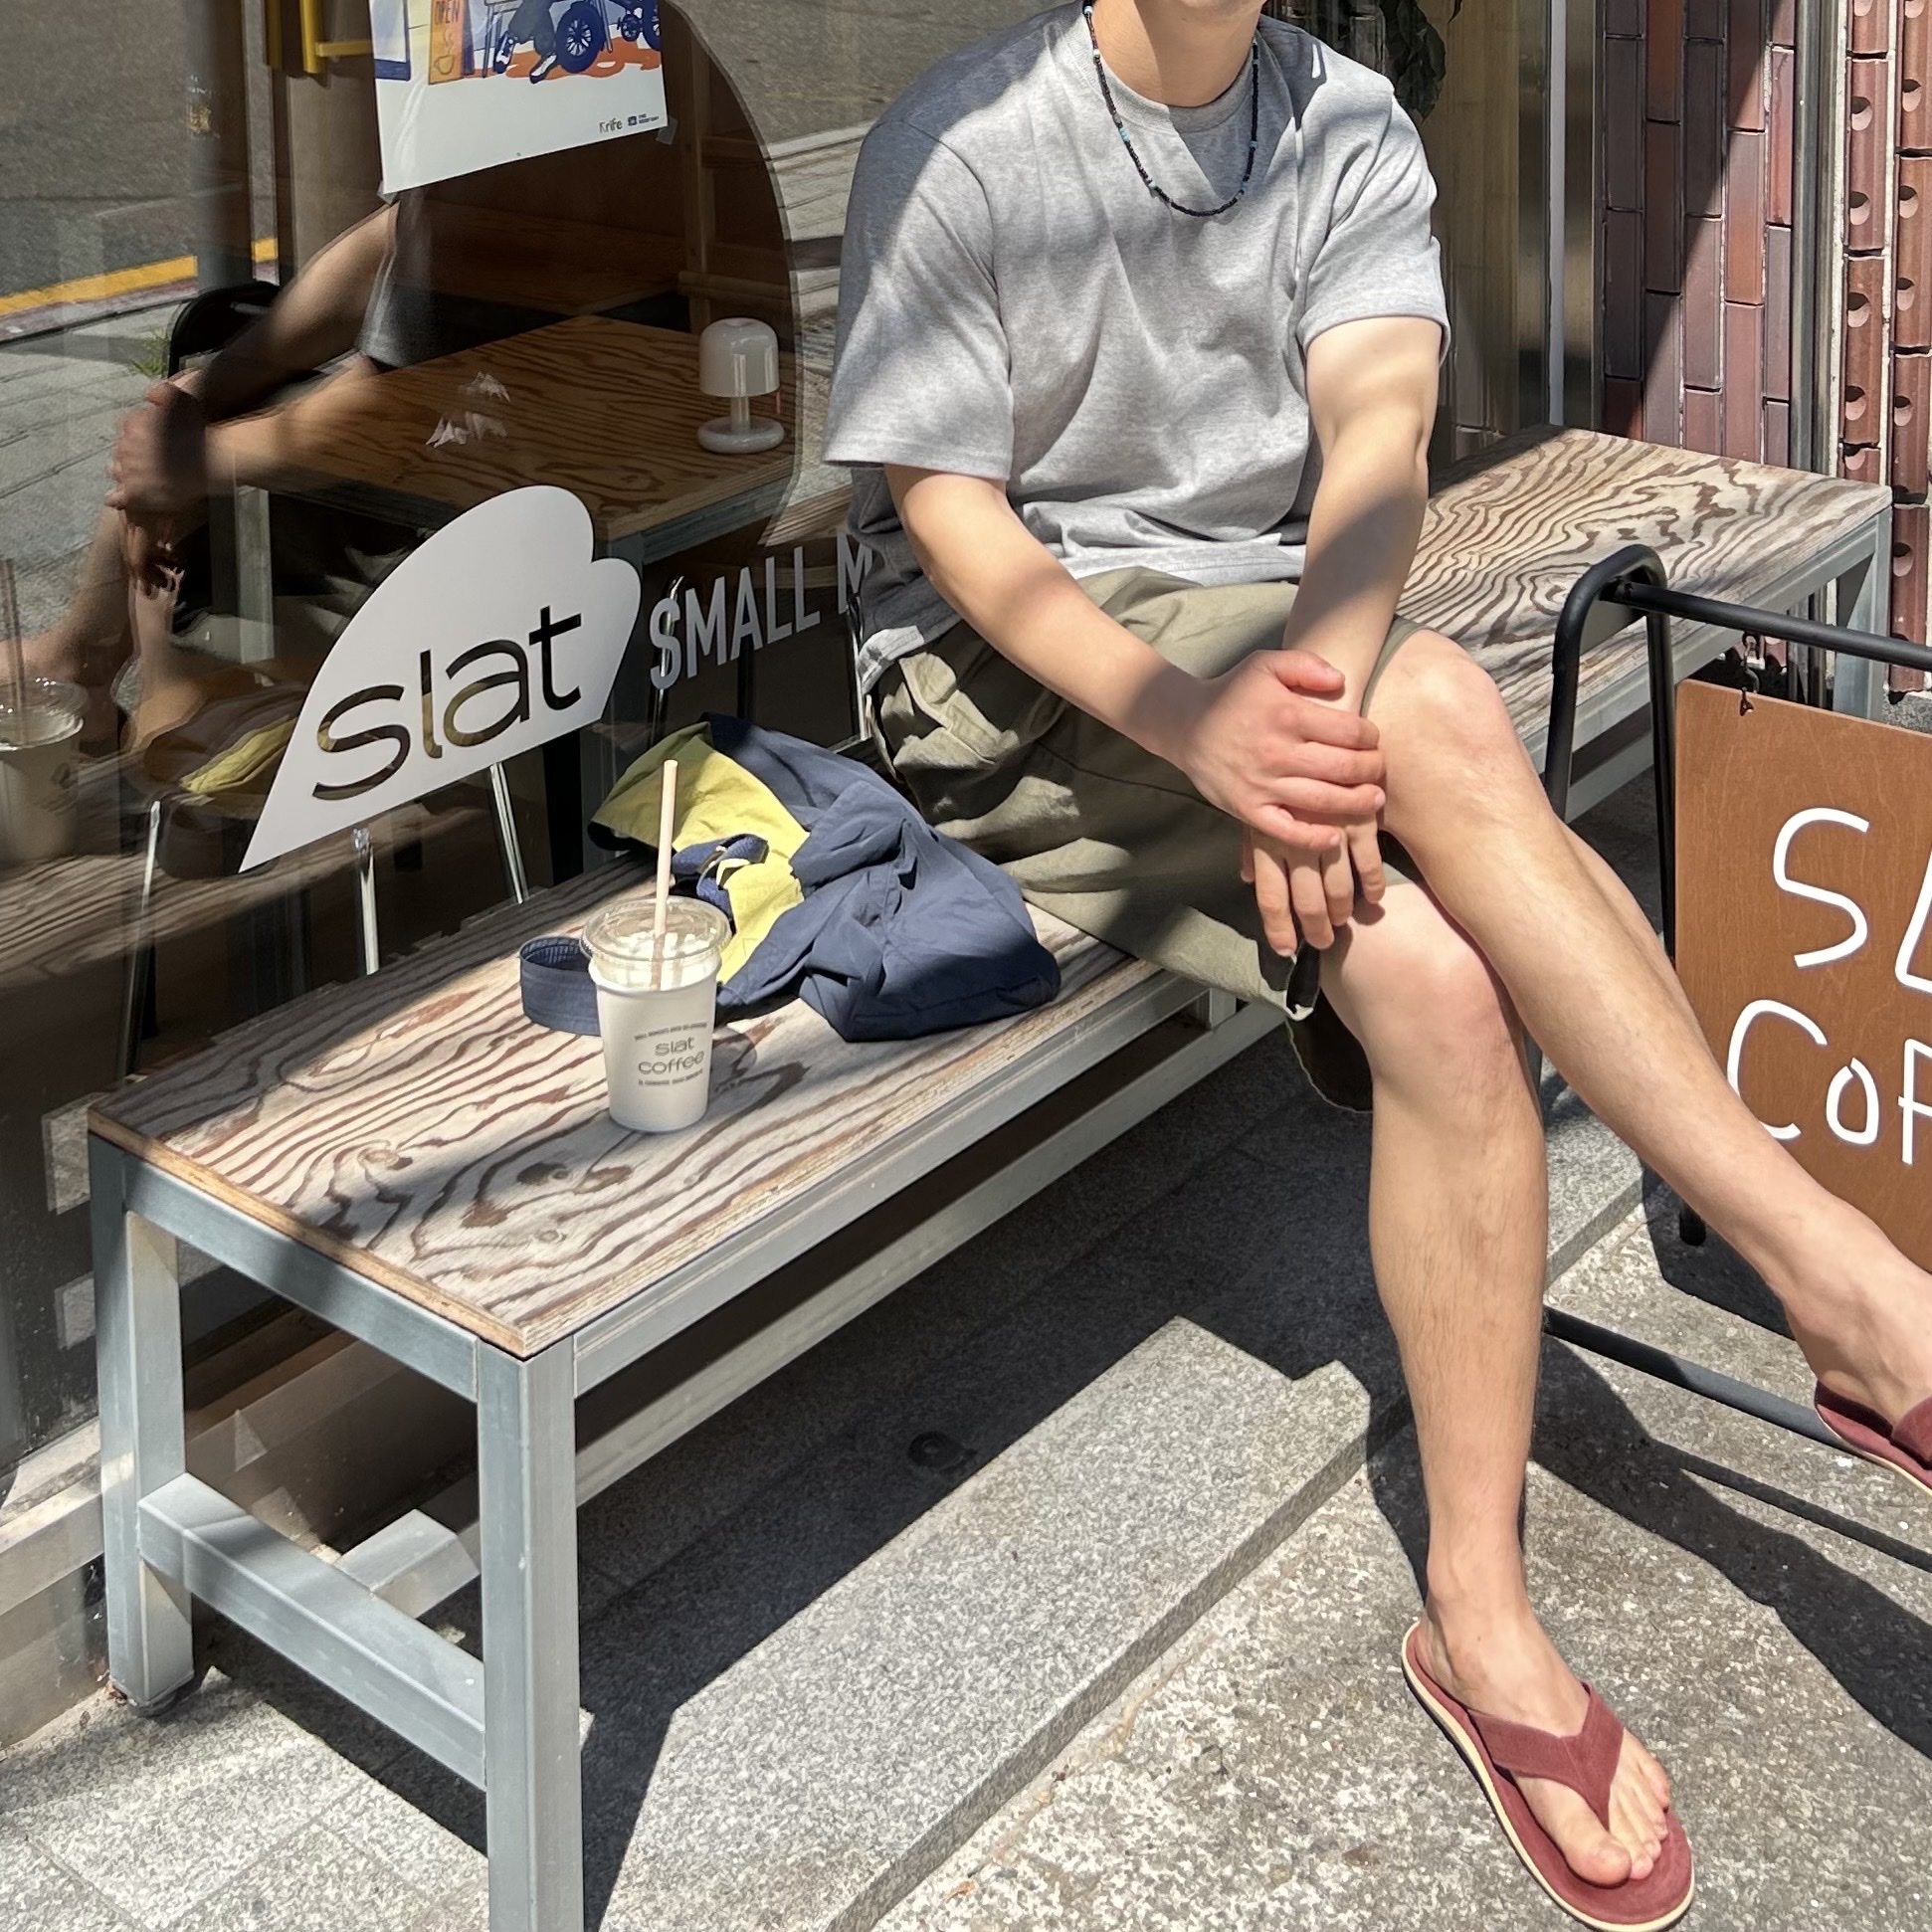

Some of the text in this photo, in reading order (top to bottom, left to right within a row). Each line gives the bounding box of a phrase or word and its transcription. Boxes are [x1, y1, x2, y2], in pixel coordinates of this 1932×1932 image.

[650, 545, 821, 689] SMALL
[312, 605, 582, 801] slat
[638, 1050, 705, 1075] coffee
[655, 1037, 695, 1057] slat
